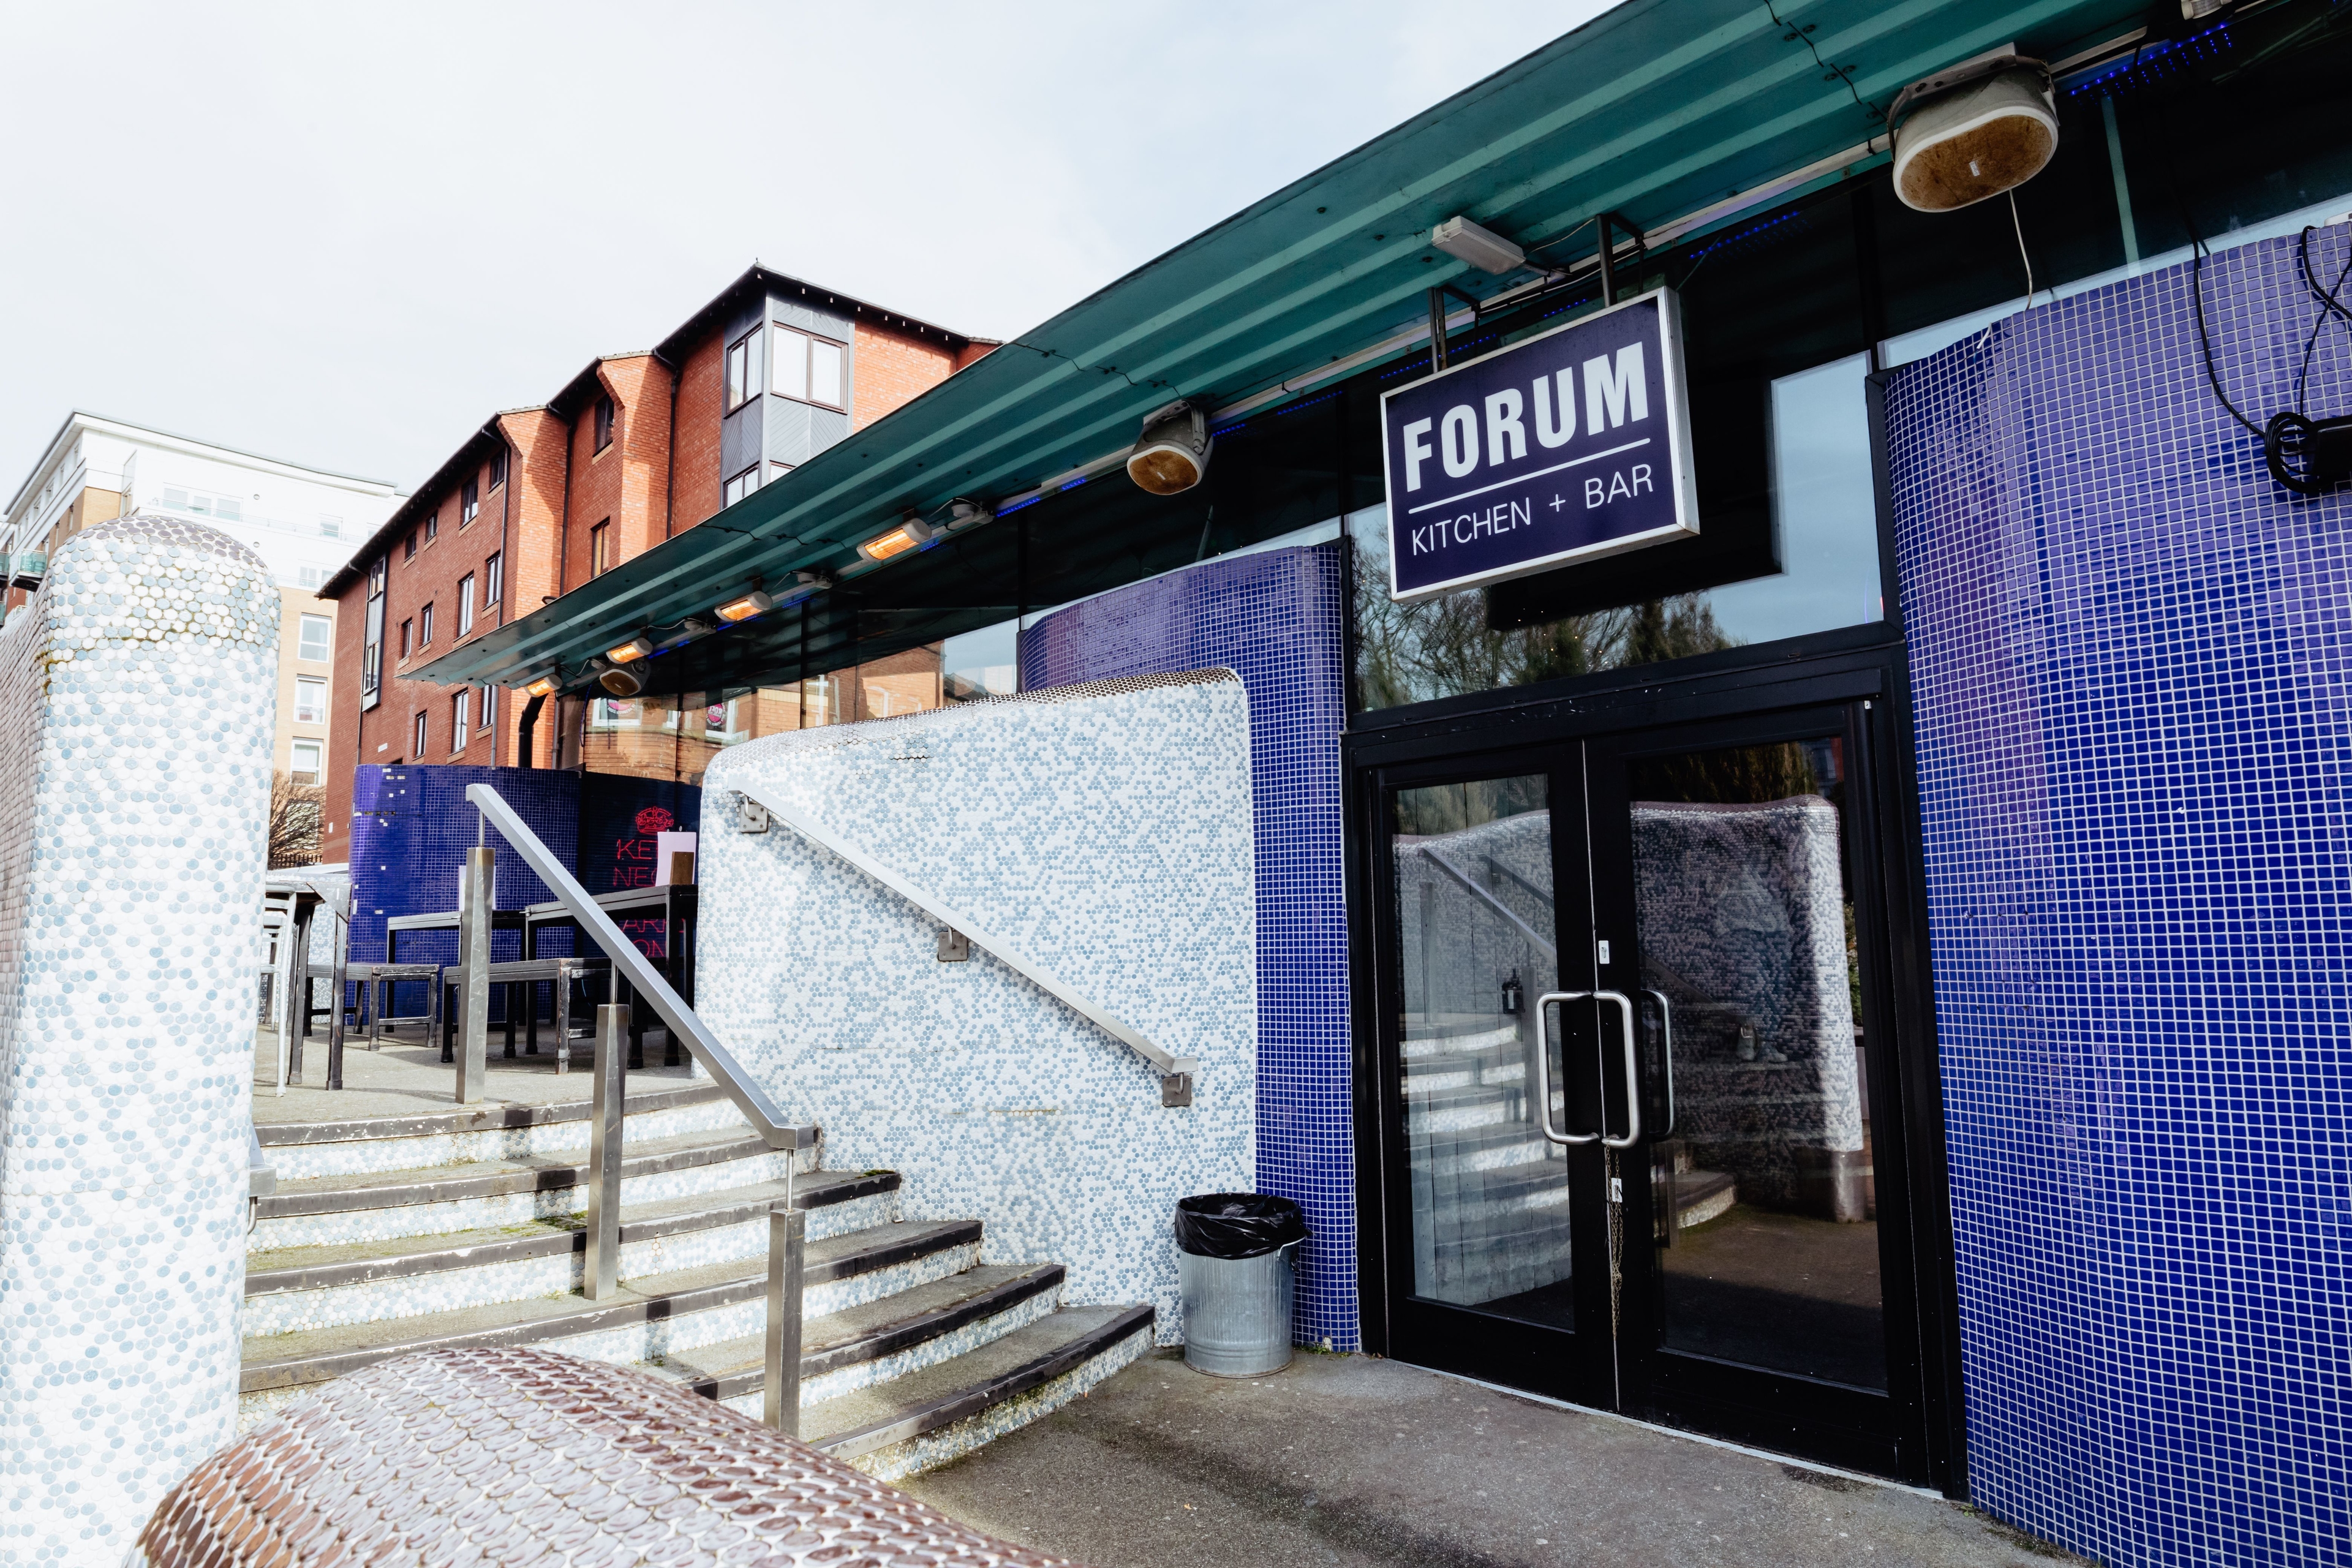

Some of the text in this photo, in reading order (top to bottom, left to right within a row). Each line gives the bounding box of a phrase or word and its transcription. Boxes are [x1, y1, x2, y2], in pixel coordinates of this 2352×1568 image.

[1403, 341, 1649, 492] FORUM
[1412, 497, 1531, 556] KITCHEN
[1585, 464, 1654, 509] BAR
